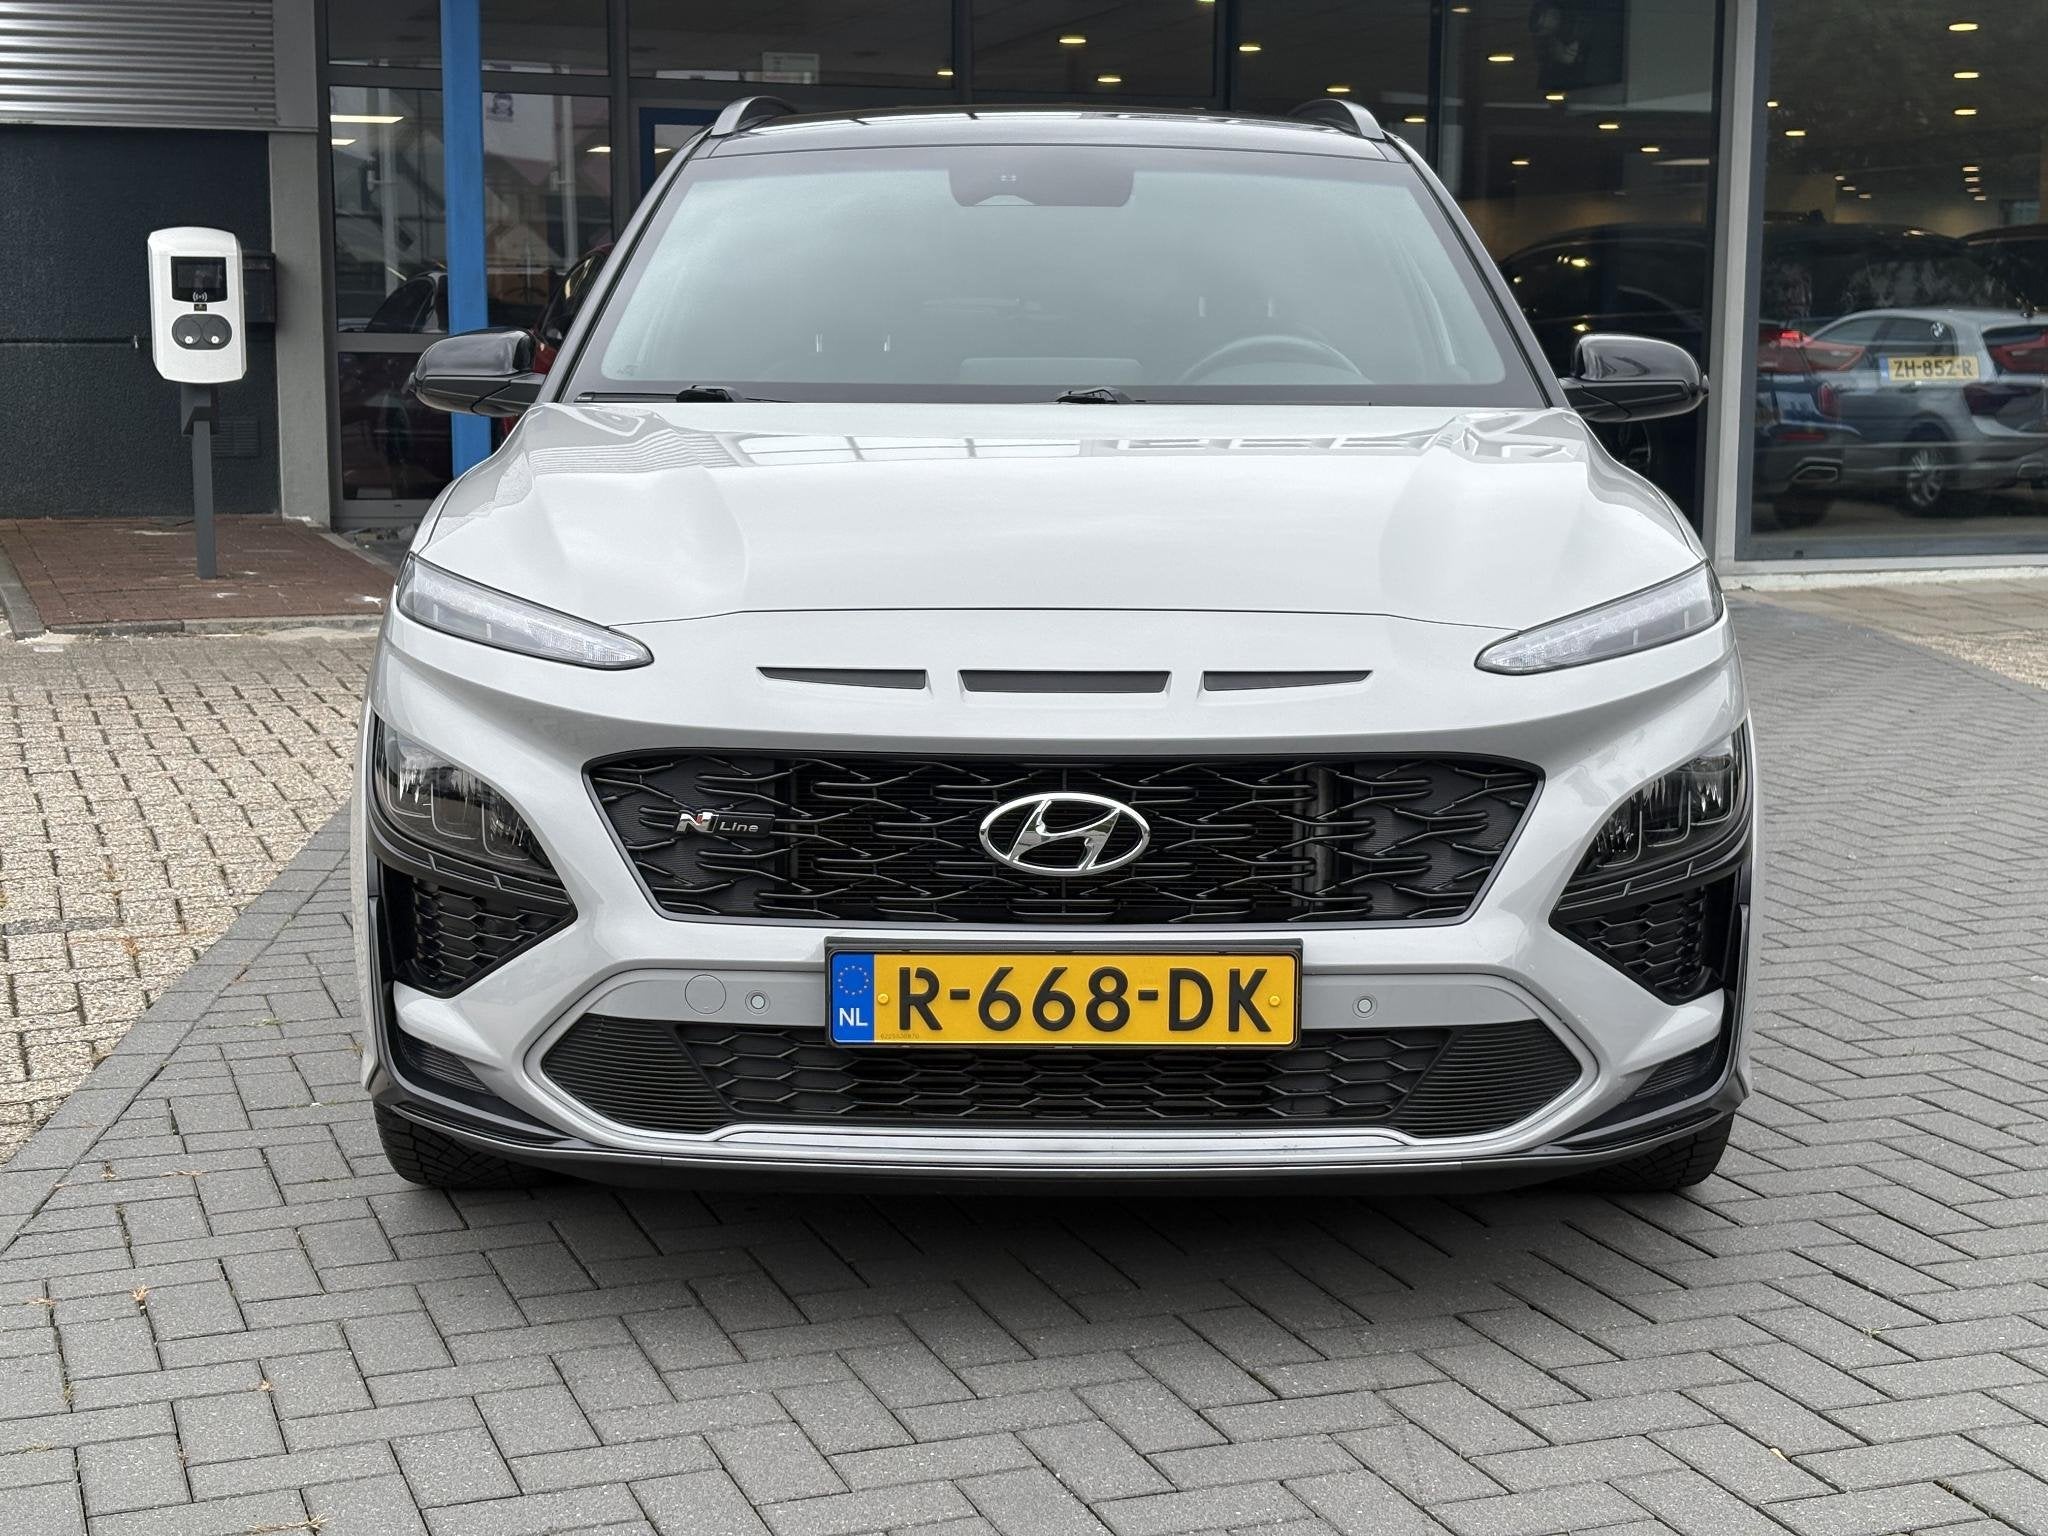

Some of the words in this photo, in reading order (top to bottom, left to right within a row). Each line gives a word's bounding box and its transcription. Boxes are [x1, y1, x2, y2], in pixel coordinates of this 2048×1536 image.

[1893, 359, 1973, 378] ZH-852-R
[719, 822, 759, 832] Line
[899, 966, 1272, 1032] R-668-DK
[839, 1007, 869, 1027] NL
